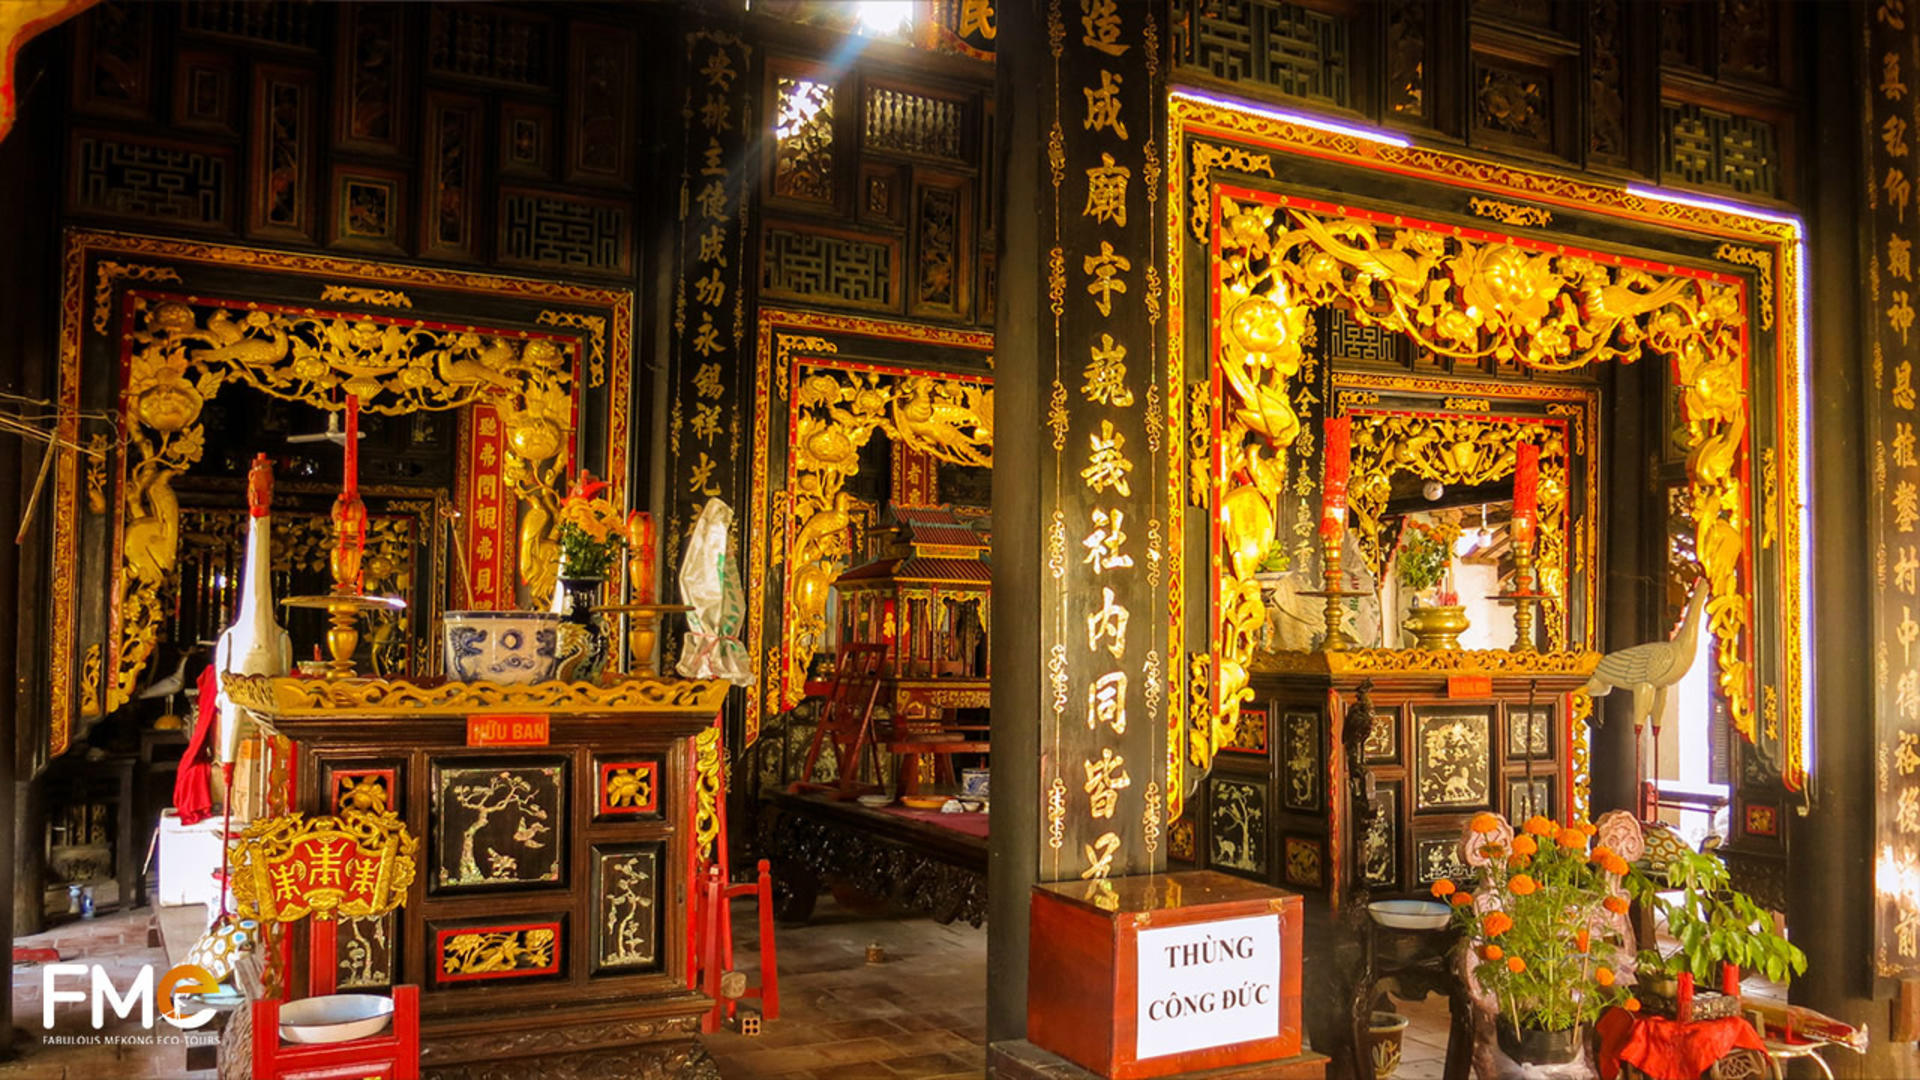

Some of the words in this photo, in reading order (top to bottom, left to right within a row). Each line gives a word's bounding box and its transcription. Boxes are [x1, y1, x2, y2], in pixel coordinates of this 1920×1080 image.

[512, 723, 545, 740] BAN
[1164, 934, 1253, 969] THÙNG
[1148, 991, 1215, 1021] CÔNG
[1222, 981, 1270, 1010] ĐỨC
